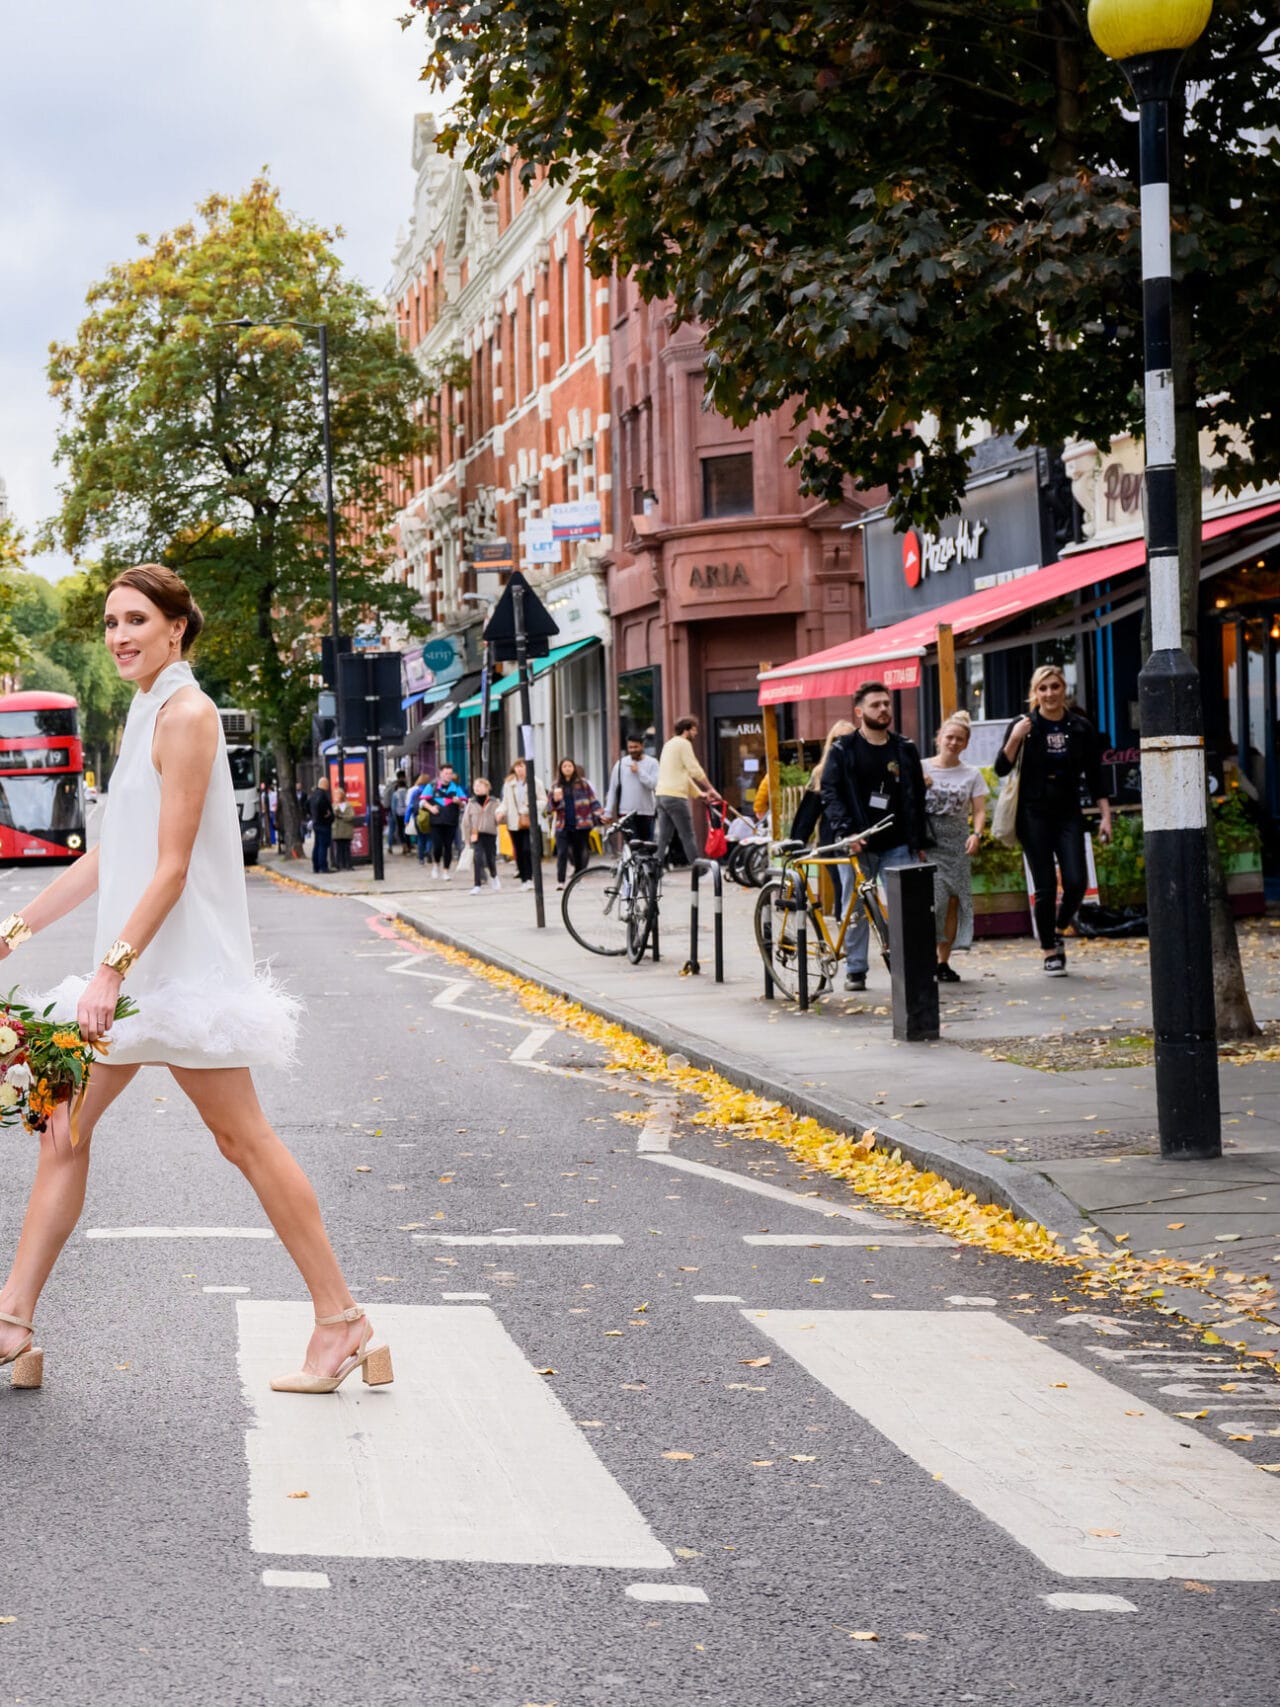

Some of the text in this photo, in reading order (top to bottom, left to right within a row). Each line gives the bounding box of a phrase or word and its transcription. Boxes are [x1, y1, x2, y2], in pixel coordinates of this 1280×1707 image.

[532, 541, 554, 552] LET
[921, 519, 985, 579] Pizza Hut
[689, 562, 750, 588] ARIA
[425, 649, 452, 661] strip
[736, 723, 762, 736] ARIA
[49, 751, 61, 763] 19
